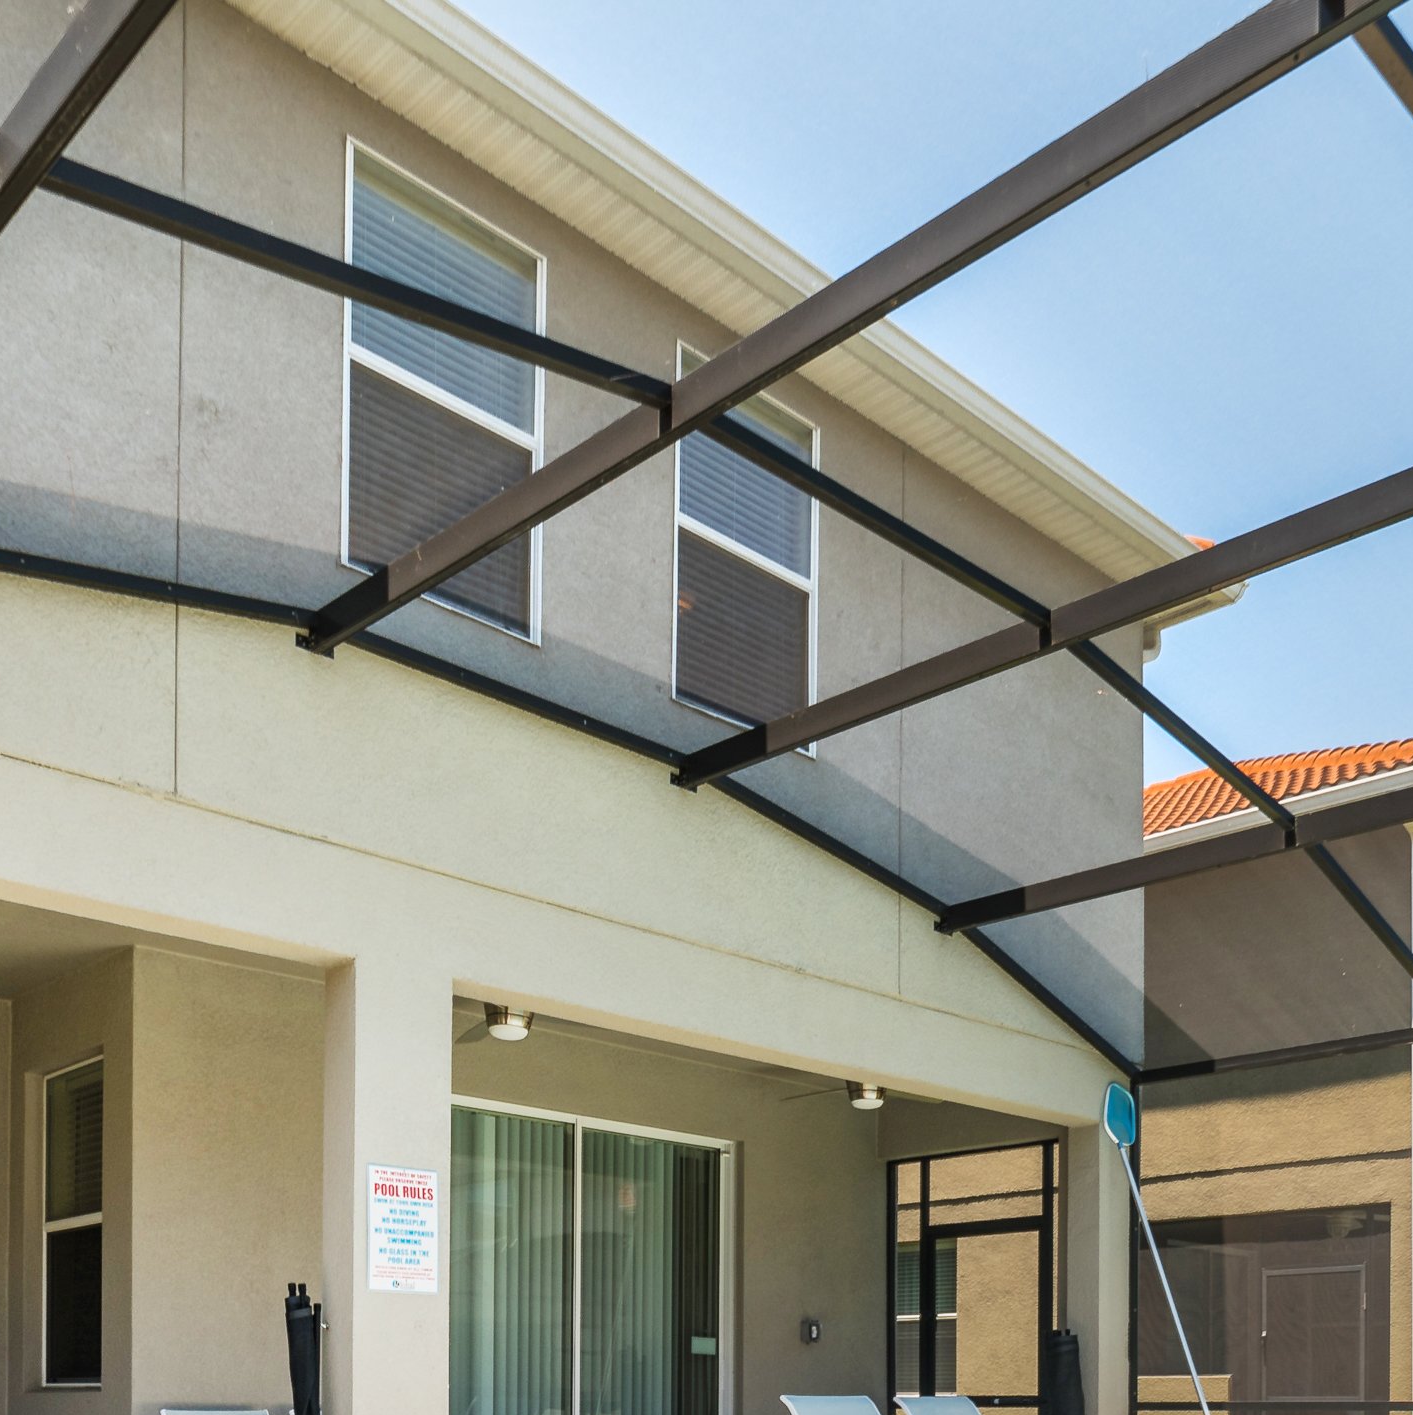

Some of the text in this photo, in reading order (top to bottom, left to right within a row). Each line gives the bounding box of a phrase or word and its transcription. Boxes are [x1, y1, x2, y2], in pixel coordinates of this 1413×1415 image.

[374, 1182, 434, 1201] POOL RULES
[392, 1218, 426, 1226] HORSEPLAY
[384, 1228, 434, 1238] UNACCOMPANIED
[387, 1237, 422, 1246] SWIMMING
